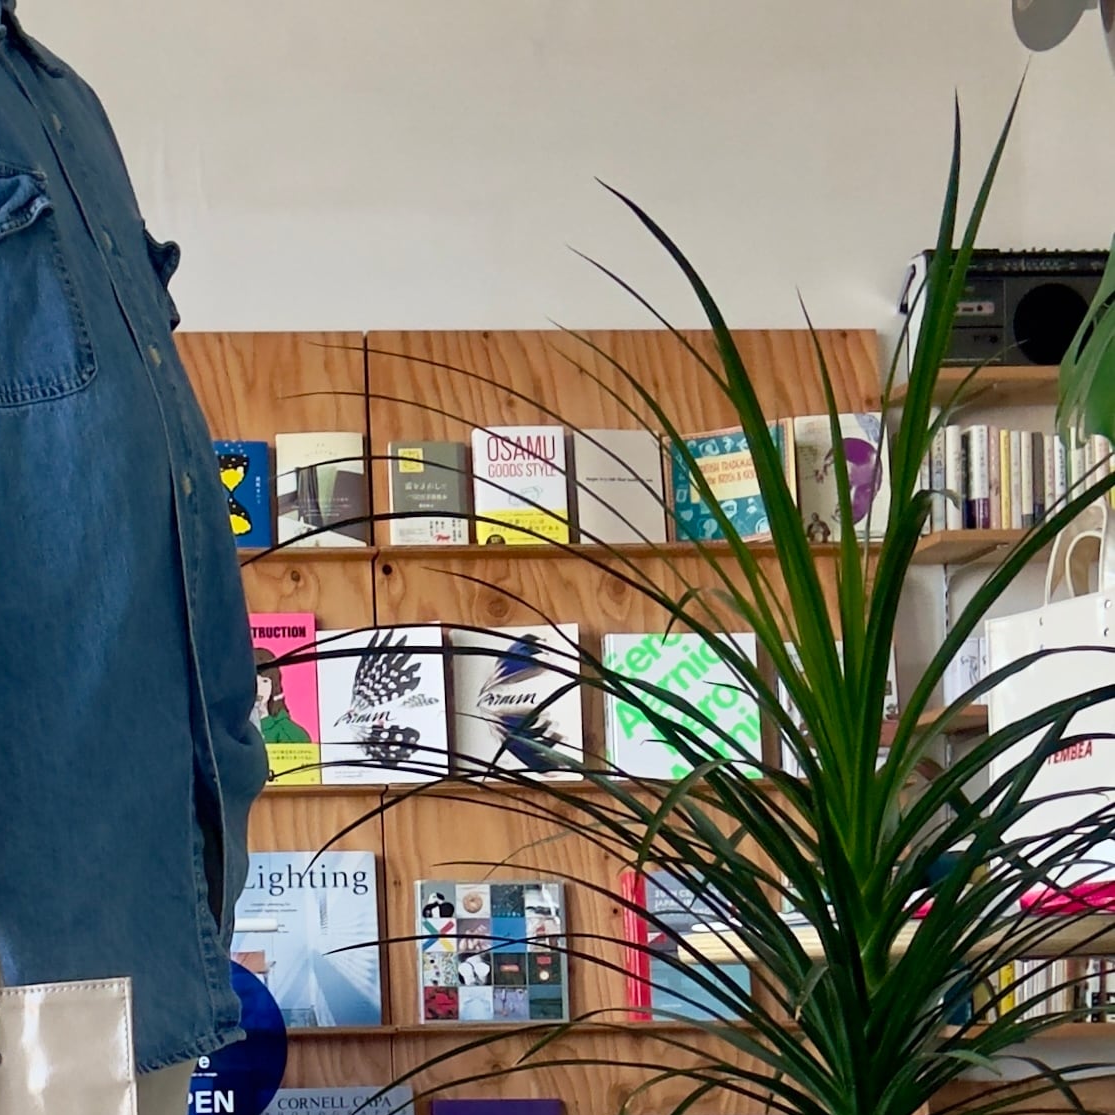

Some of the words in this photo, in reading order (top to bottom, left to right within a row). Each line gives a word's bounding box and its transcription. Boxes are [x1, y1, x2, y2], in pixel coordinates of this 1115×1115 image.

[487, 435, 557, 462] OSAMU
[488, 462, 524, 478] GOODS
[525, 460, 556, 477] STYLE
[277, 1096, 349, 1111] CORNELL
[353, 1094, 393, 1110] CAPA
